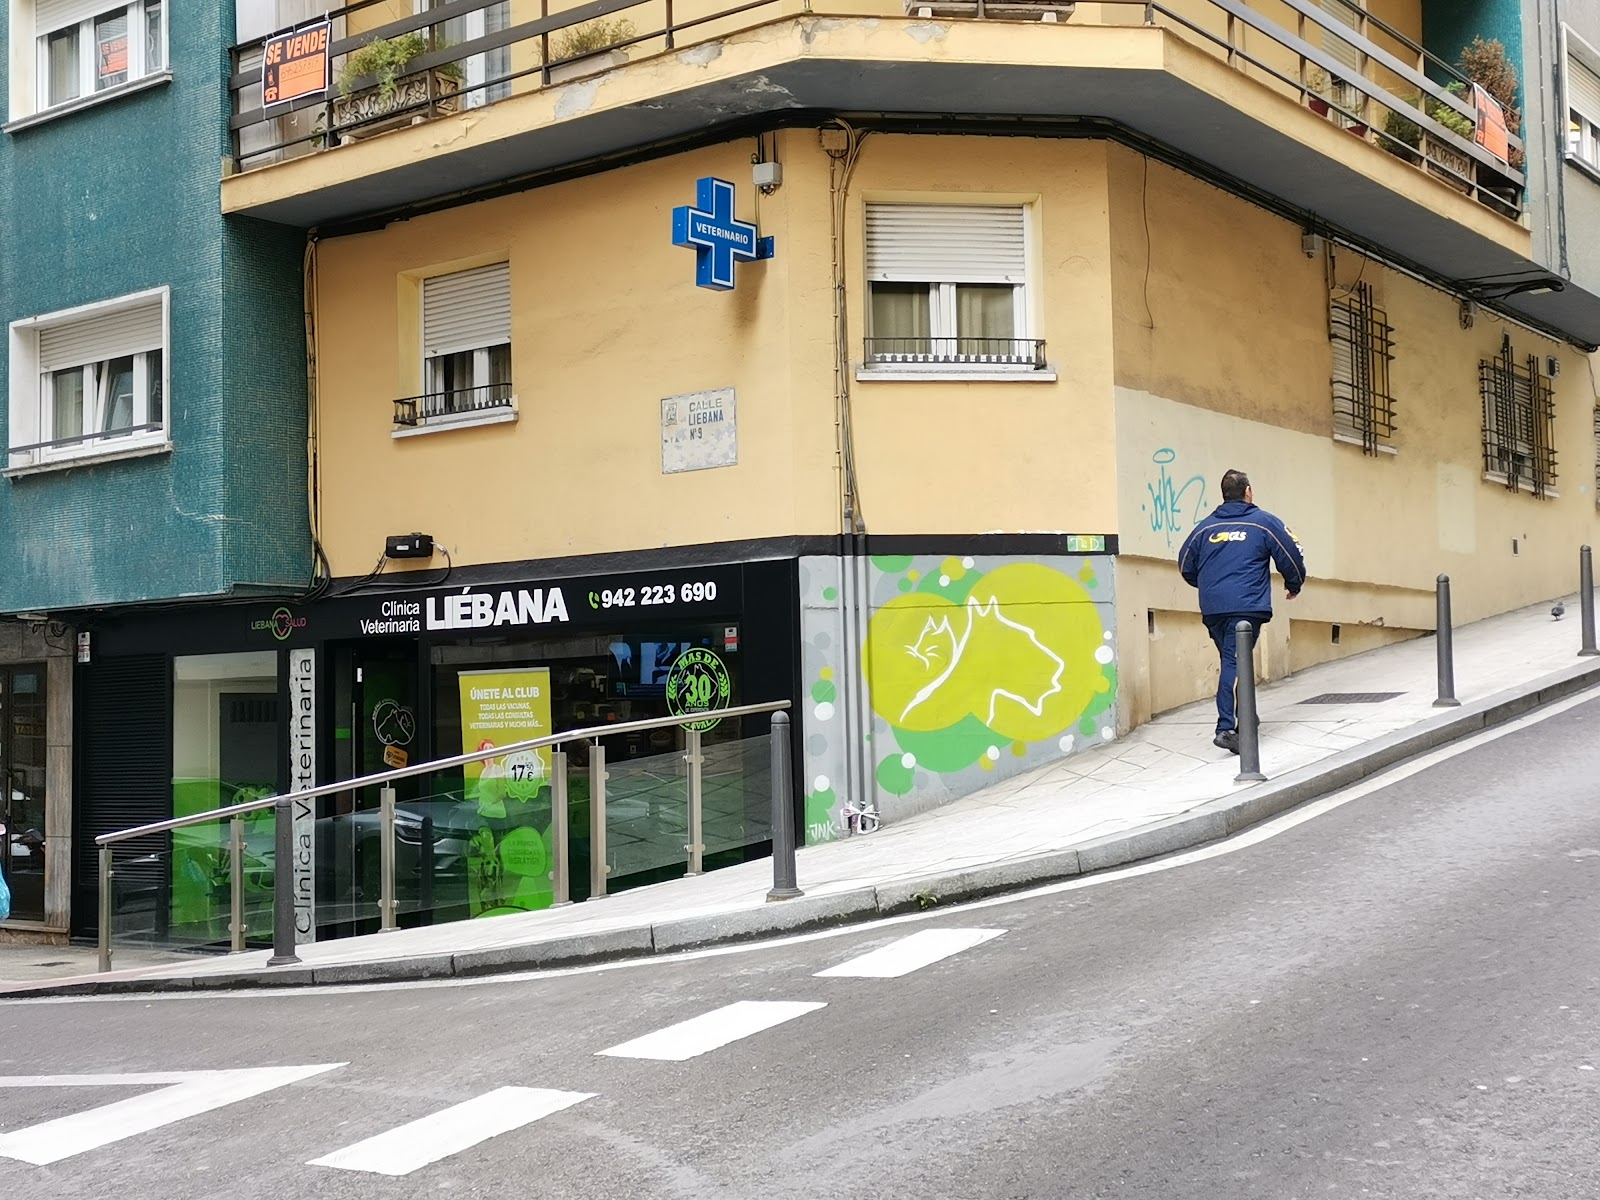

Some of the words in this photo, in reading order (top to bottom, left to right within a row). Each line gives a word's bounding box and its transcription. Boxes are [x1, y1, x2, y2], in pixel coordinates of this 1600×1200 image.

[266, 42, 282, 65] SE
[286, 28, 327, 59] VENDE
[696, 222, 749, 244] VETERINARIO
[689, 398, 722, 412] CALLE
[689, 410, 724, 426] LIEBANA
[1229, 531, 1247, 541] GLS
[601, 588, 635, 608] 942
[641, 585, 676, 605] 223
[681, 581, 717, 602] 690
[382, 600, 420, 616] Clínica
[426, 587, 570, 630] LIÉBANA
[285, 617, 306, 627] SALUD
[360, 617, 420, 634] Veterinaria
[704, 653, 719, 669] DE
[470, 687, 500, 700] ÚNETE
[502, 688, 514, 699] AL
[515, 686, 540, 698] CLUB
[685, 674, 711, 703] 30
[511, 764, 525, 782] 17
[294, 833, 312, 934] Clínica
